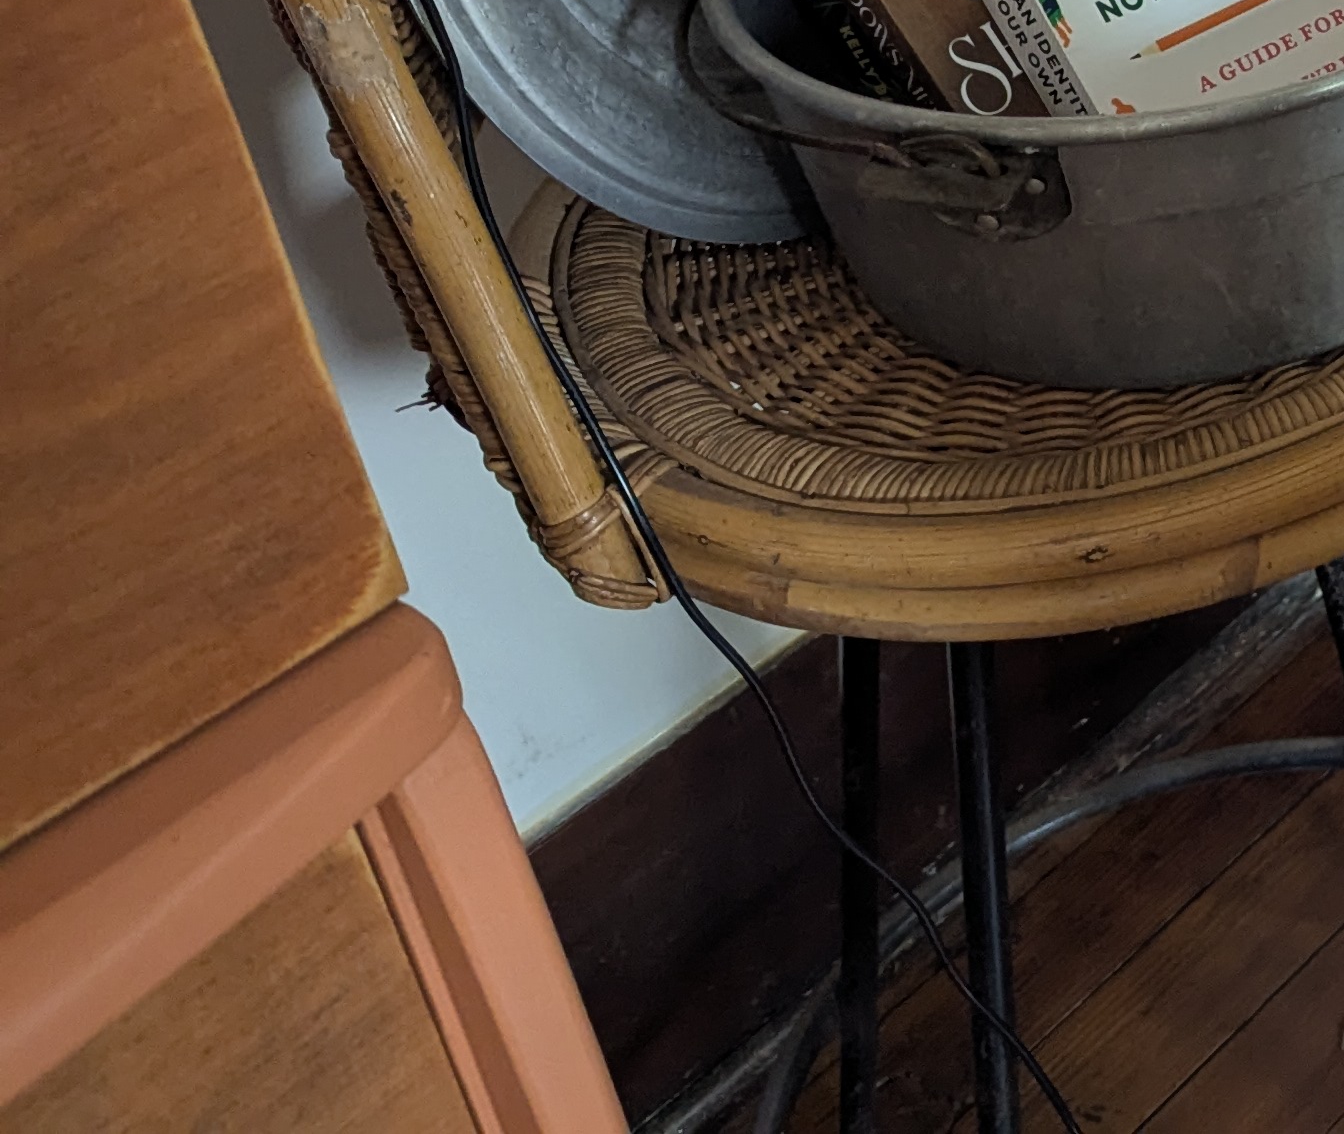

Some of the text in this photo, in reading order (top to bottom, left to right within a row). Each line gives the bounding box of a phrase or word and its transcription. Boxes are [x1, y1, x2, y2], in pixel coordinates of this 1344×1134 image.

[839, 25, 882, 79] KELLY
[1028, 52, 1062, 105] OWN
[1033, 31, 1088, 115] IDENTIT
[1200, 75, 1217, 93] A
[1218, 33, 1298, 81] GUIDE
